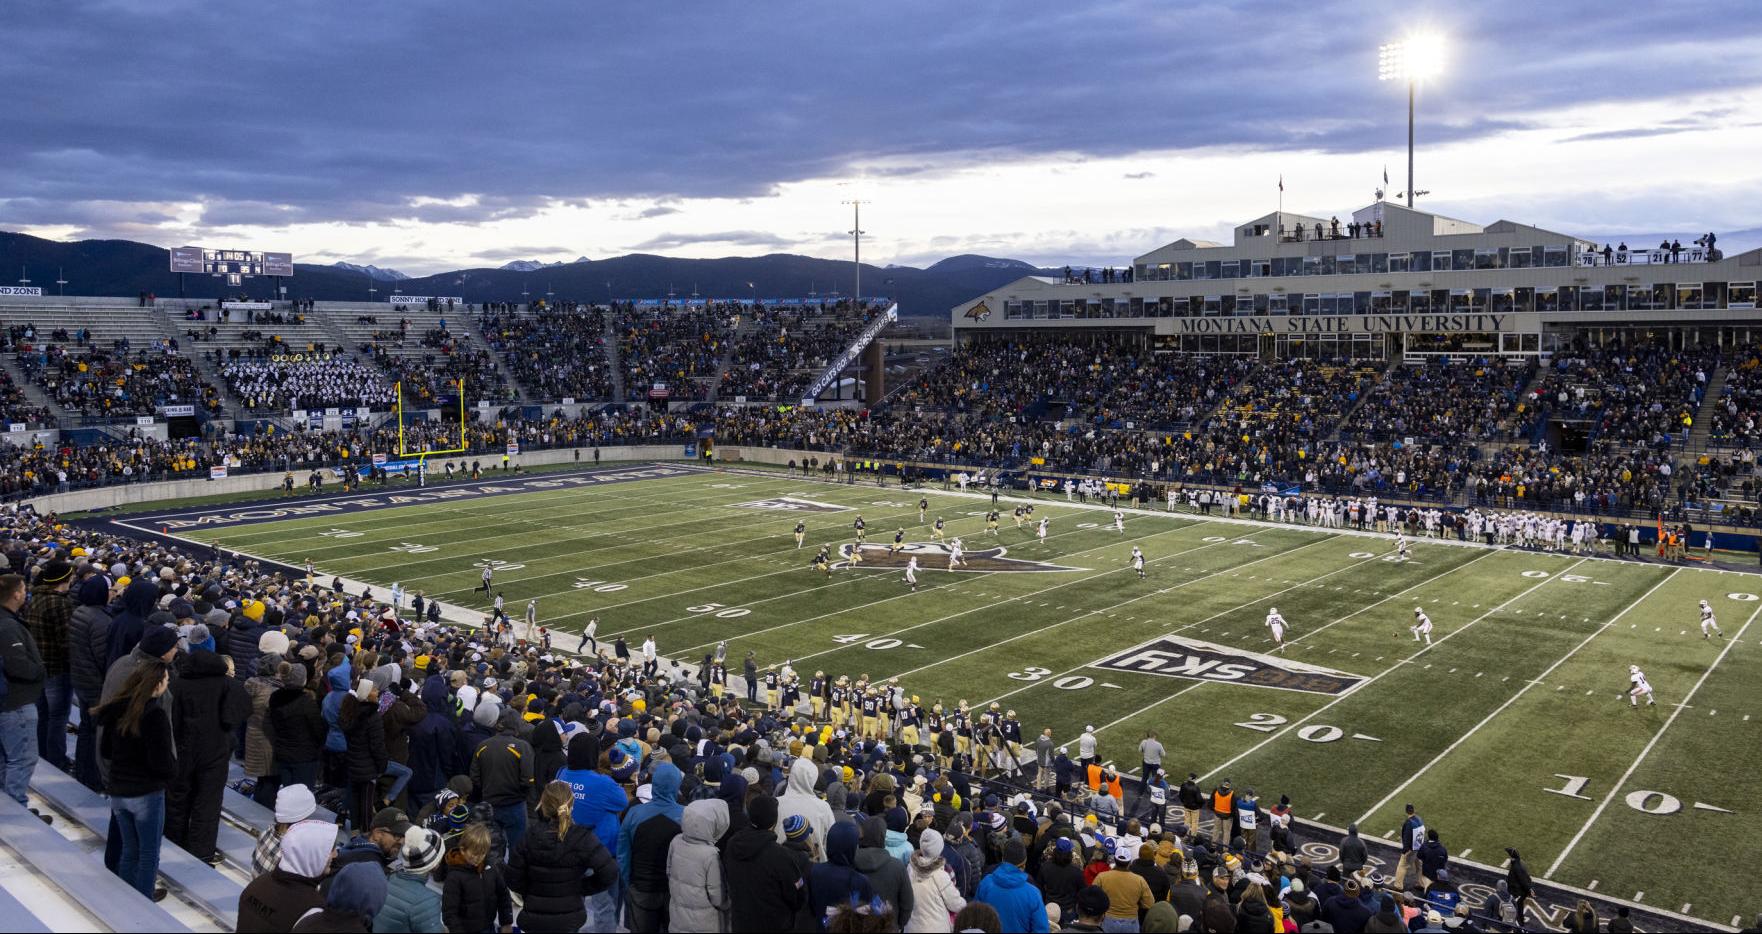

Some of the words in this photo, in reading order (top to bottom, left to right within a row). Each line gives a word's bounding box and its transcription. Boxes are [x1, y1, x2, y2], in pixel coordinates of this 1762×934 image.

[1582, 256, 1593, 265] 78
[1616, 253, 1626, 264] 52
[1653, 253, 1662, 262] 21
[1692, 252, 1703, 261] 77
[13, 287, 40, 295] ZONE
[1181, 318, 1274, 333] MONTANA
[1288, 316, 1349, 332] STATE
[1363, 314, 1506, 332] UNIVERSITY
[811, 383, 822, 396] GO
[821, 367, 837, 387] CATS
[836, 357, 848, 371] GO!
[155, 485, 526, 529] MONTANA
[524, 468, 690, 488] STATE
[686, 602, 752, 618] 50
[1269, 616, 1280, 626] 25
[831, 633, 904, 650] 40
[1112, 649, 1256, 680] SKY
[766, 674, 774, 682] 20
[1006, 666, 1095, 691] 30
[812, 681, 818, 690] 1
[864, 701, 874, 712] 90
[900, 710, 908, 720] 10
[1006, 724, 1012, 733] 3
[1233, 712, 1344, 743] 20
[573, 783, 585, 791] GO
[1543, 773, 1681, 815] 10
